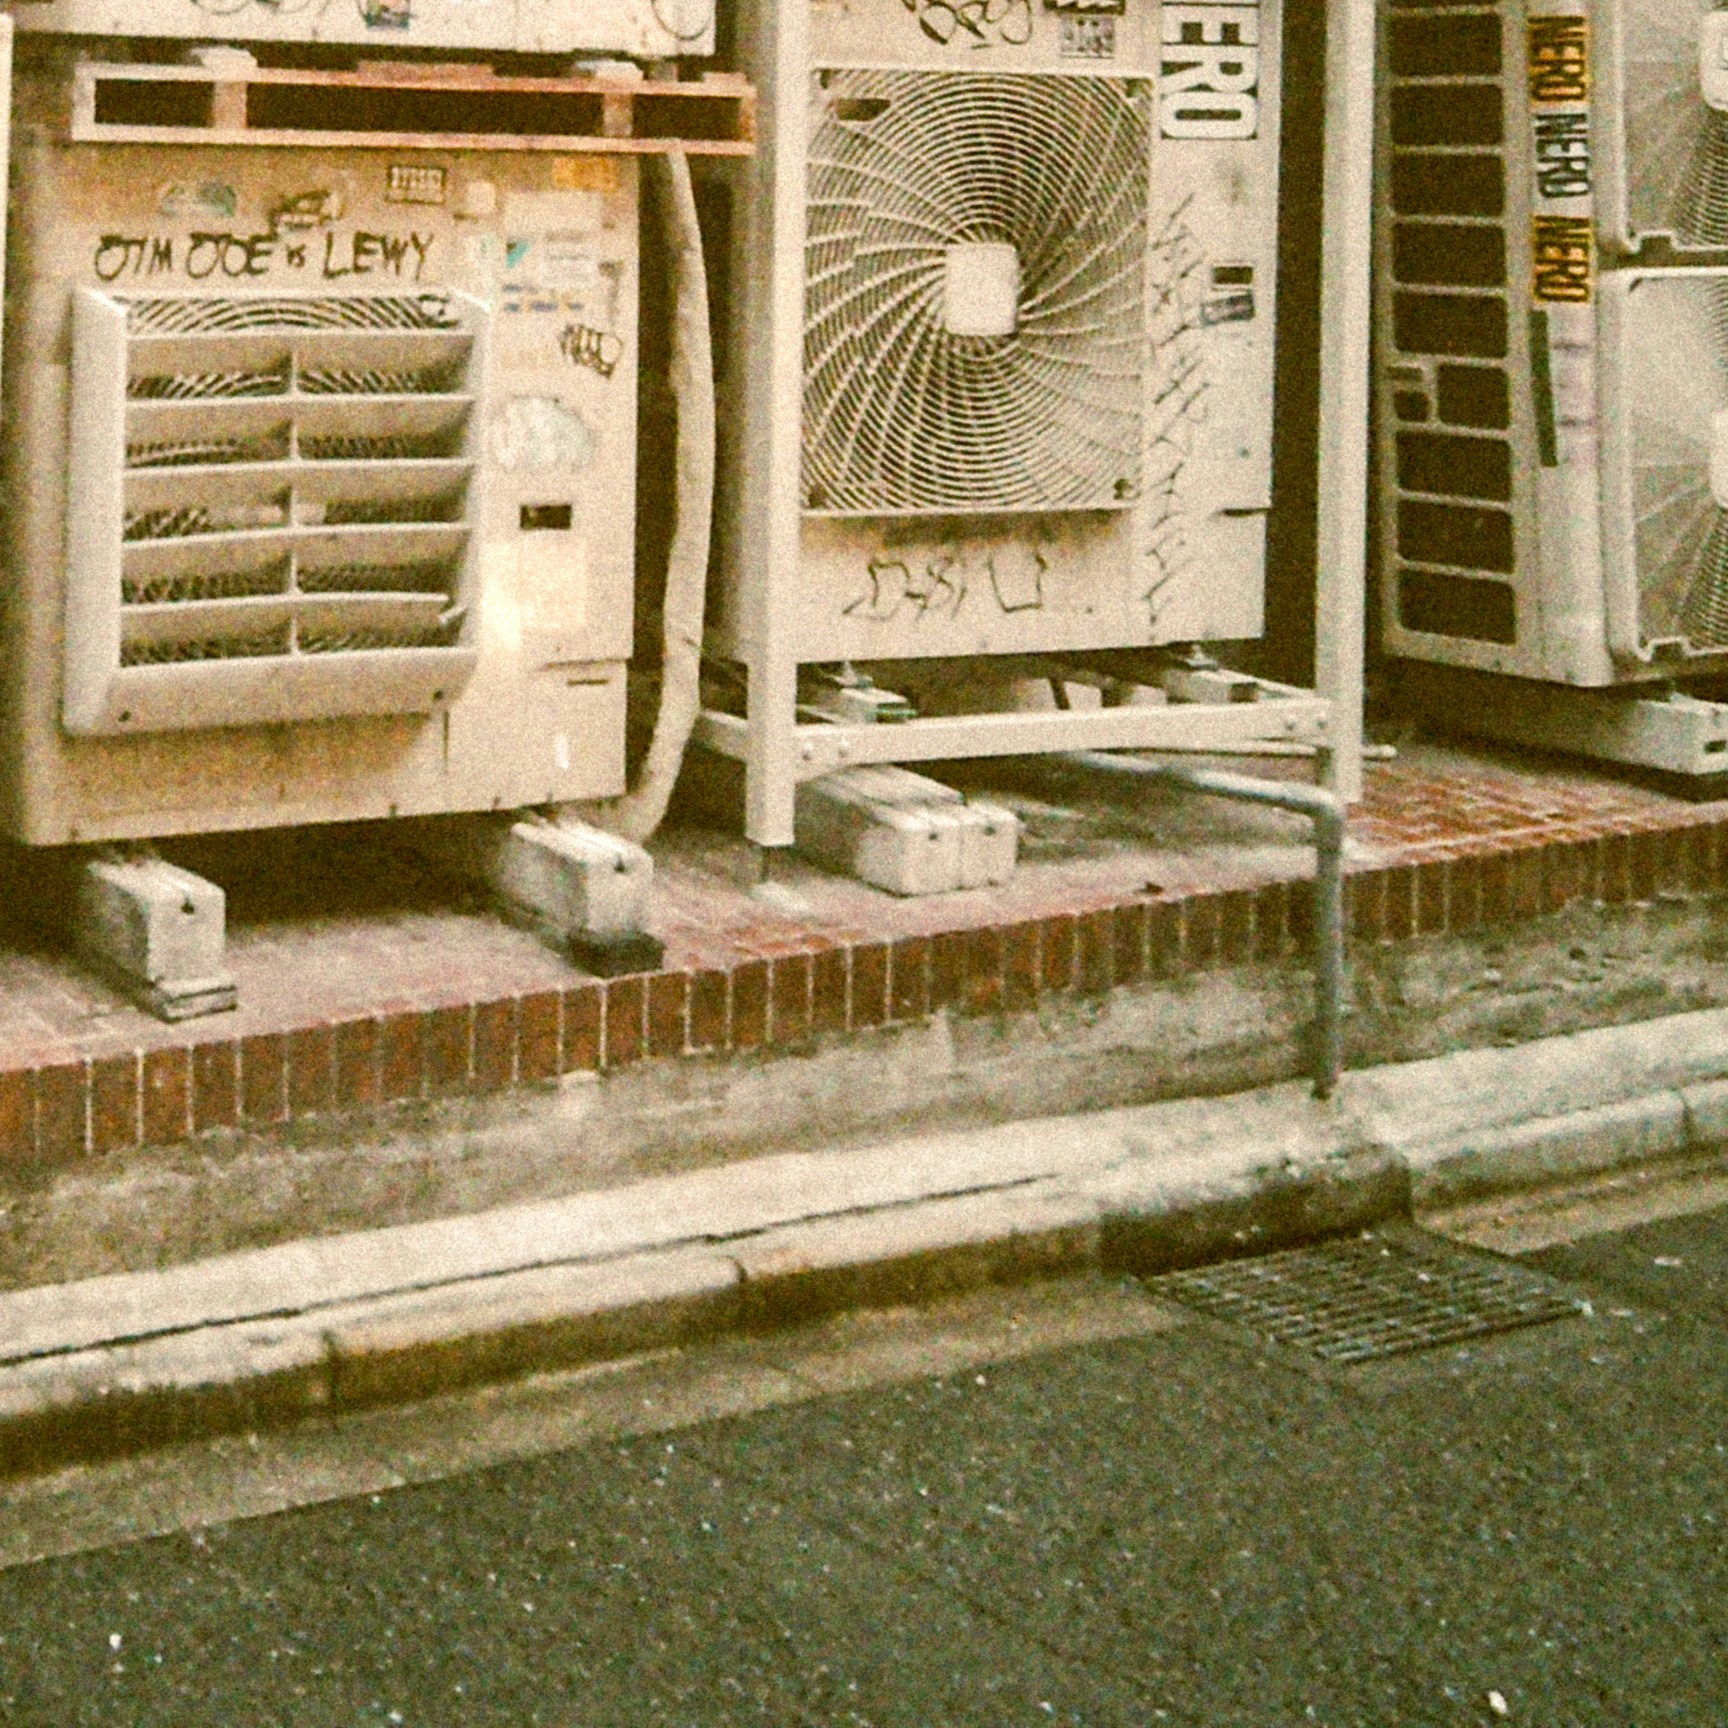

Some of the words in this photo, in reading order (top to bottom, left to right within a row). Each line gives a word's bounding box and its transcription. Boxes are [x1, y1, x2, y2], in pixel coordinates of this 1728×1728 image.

[1531, 15, 1590, 103] NERO
[1535, 112, 1593, 199] NERO
[1534, 214, 1592, 304] NERO
